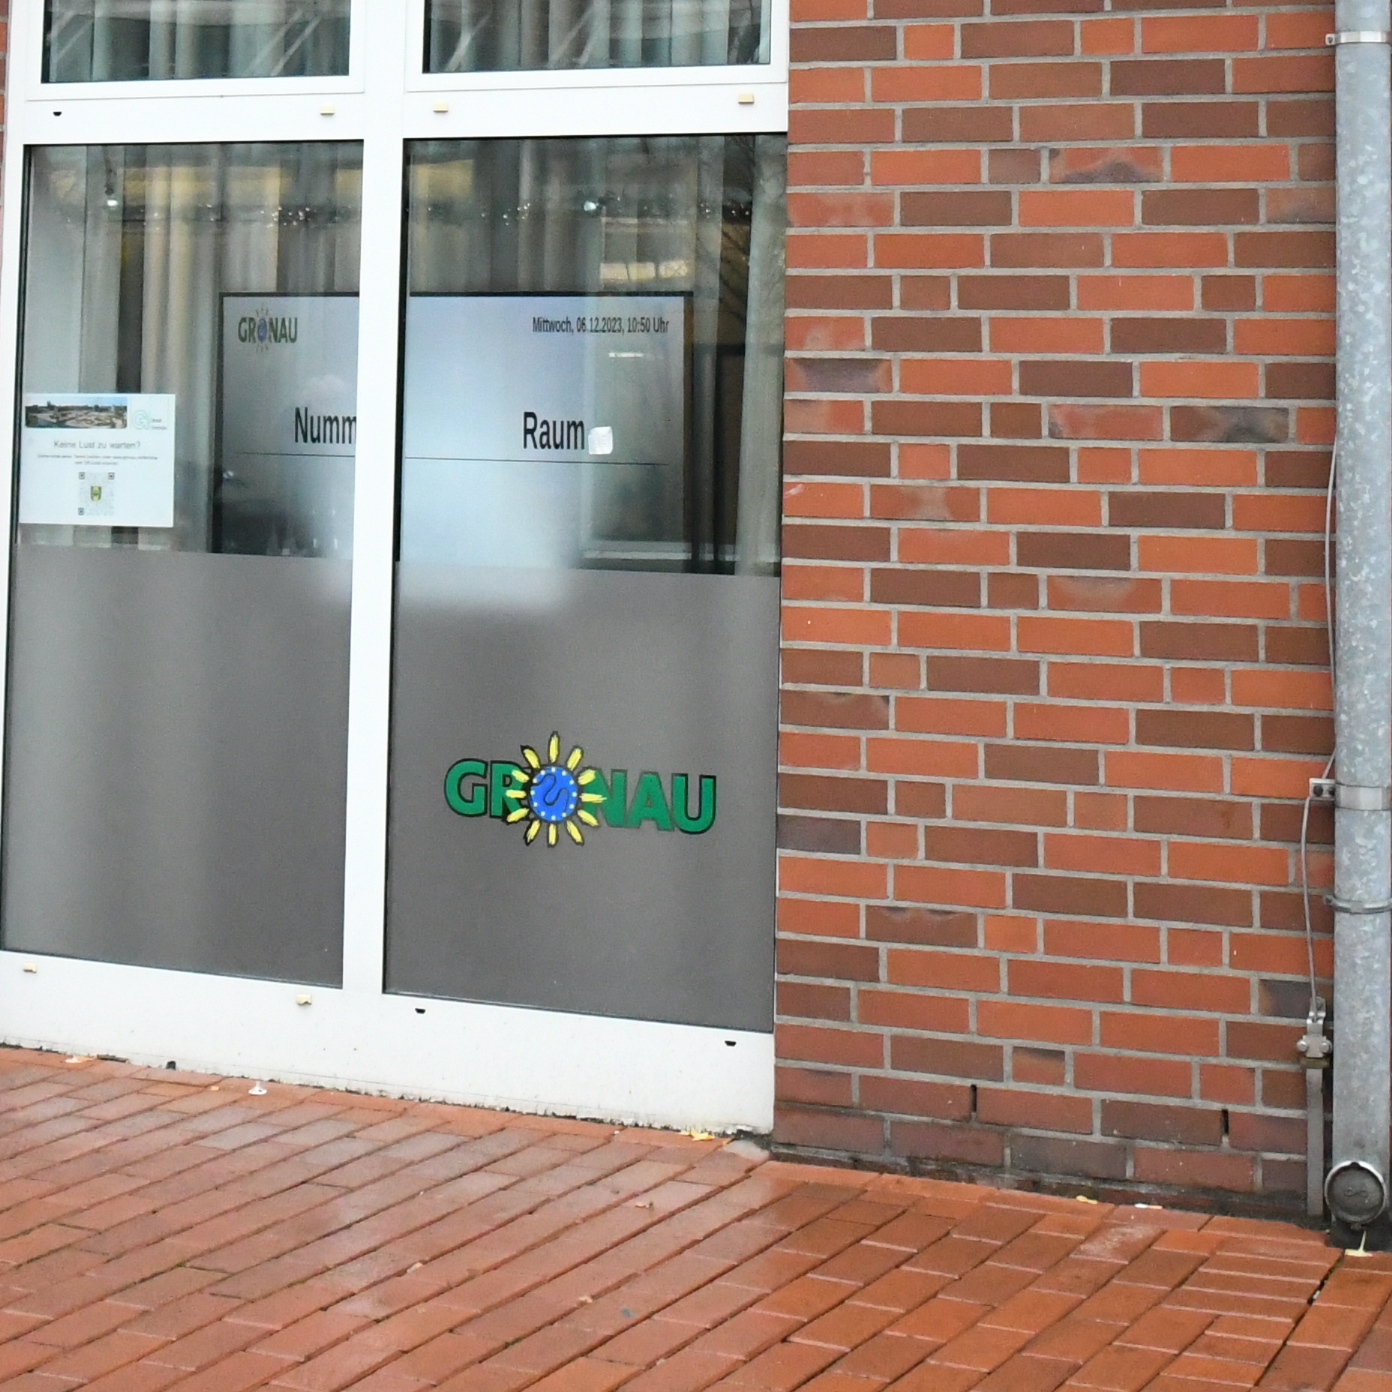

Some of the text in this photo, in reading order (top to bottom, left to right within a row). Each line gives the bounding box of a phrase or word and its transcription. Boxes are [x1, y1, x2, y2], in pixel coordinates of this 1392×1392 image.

[532, 316, 574, 335] Mittwoch,
[627, 317, 650, 333] 10:50
[653, 316, 669, 333] Uhr
[522, 410, 586, 450] Raum
[79, 440, 95, 449] Lust
